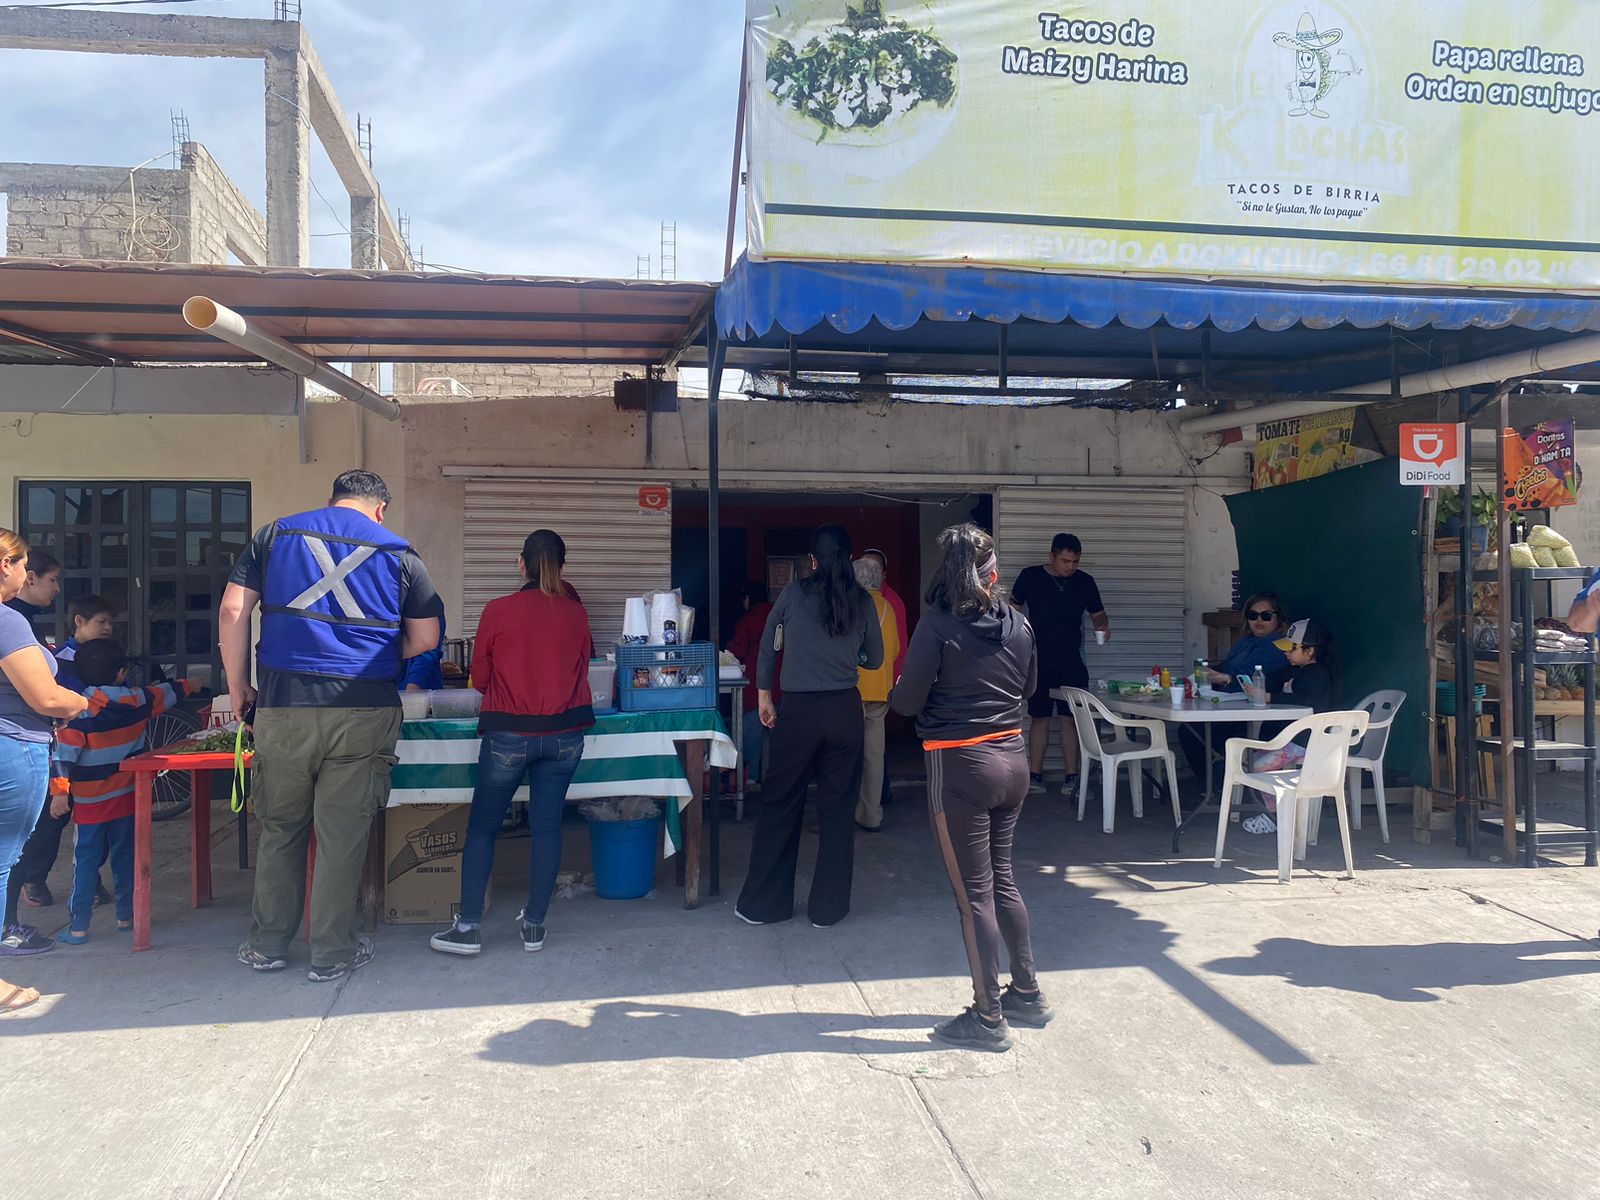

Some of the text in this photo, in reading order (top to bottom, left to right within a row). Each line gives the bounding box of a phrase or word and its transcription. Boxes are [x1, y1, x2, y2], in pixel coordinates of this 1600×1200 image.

[1039, 12, 1155, 48] Tacos de
[1002, 46, 1188, 85] Maiz y Harina
[1433, 40, 1584, 77] Papa rellena
[1405, 72, 1484, 103] Orden
[1486, 82, 1519, 106] en
[1521, 84, 1551, 109] su
[1227, 183, 1380, 203] TACOS DE BIRRIA
[1252, 204, 1264, 212] no
[1309, 204, 1321, 215] No
[1323, 206, 1336, 216] los
[1257, 419, 1300, 441] TOMATE
[1537, 433, 1566, 444] Doritos
[1533, 447, 1571, 465] DNAMTA
[1406, 471, 1451, 481] DiDi Food
[1515, 468, 1548, 499] Cheetos
[420, 831, 457, 849] VASOS
